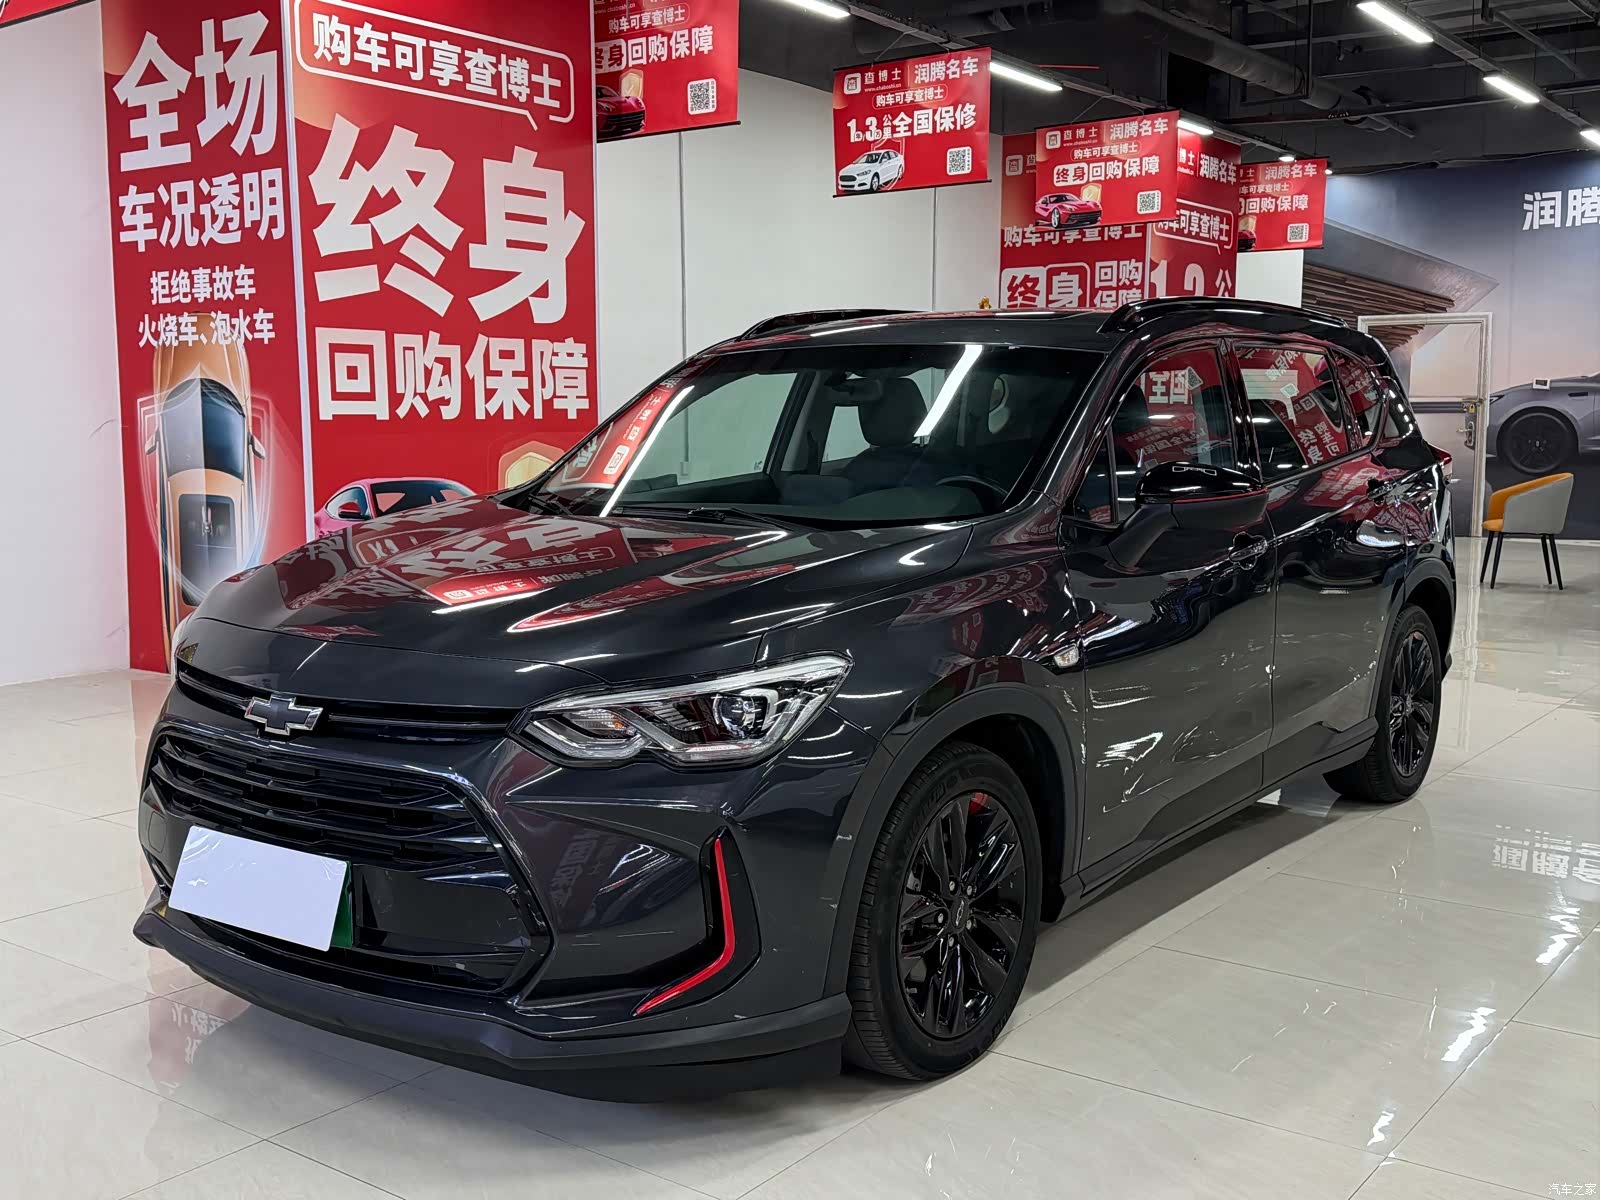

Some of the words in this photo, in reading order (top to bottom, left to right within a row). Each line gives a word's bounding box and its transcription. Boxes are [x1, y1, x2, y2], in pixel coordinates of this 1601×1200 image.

[609, 5, 686, 34] 购车可享查博士
[311, 14, 563, 110] 购车可享查博士
[113, 10, 282, 173] 全场
[876, 86, 944, 108] 购车可享查博士
[1073, 143, 1139, 160] 购车可享查博士
[1239, 182, 1290, 195] 车可享查博士
[1246, 193, 1309, 215] 回购保障
[1522, 186, 1600, 231] 润腾
[118, 168, 286, 253] 车况透明
[308, 114, 586, 323] 终身
[149, 265, 256, 306] 拒绝事故车
[1006, 271, 1084, 309] 终身
[1094, 258, 1143, 288] 回购
[137, 308, 276, 349] 火烧车、泡水车
[315, 326, 590, 421] 回购保障
